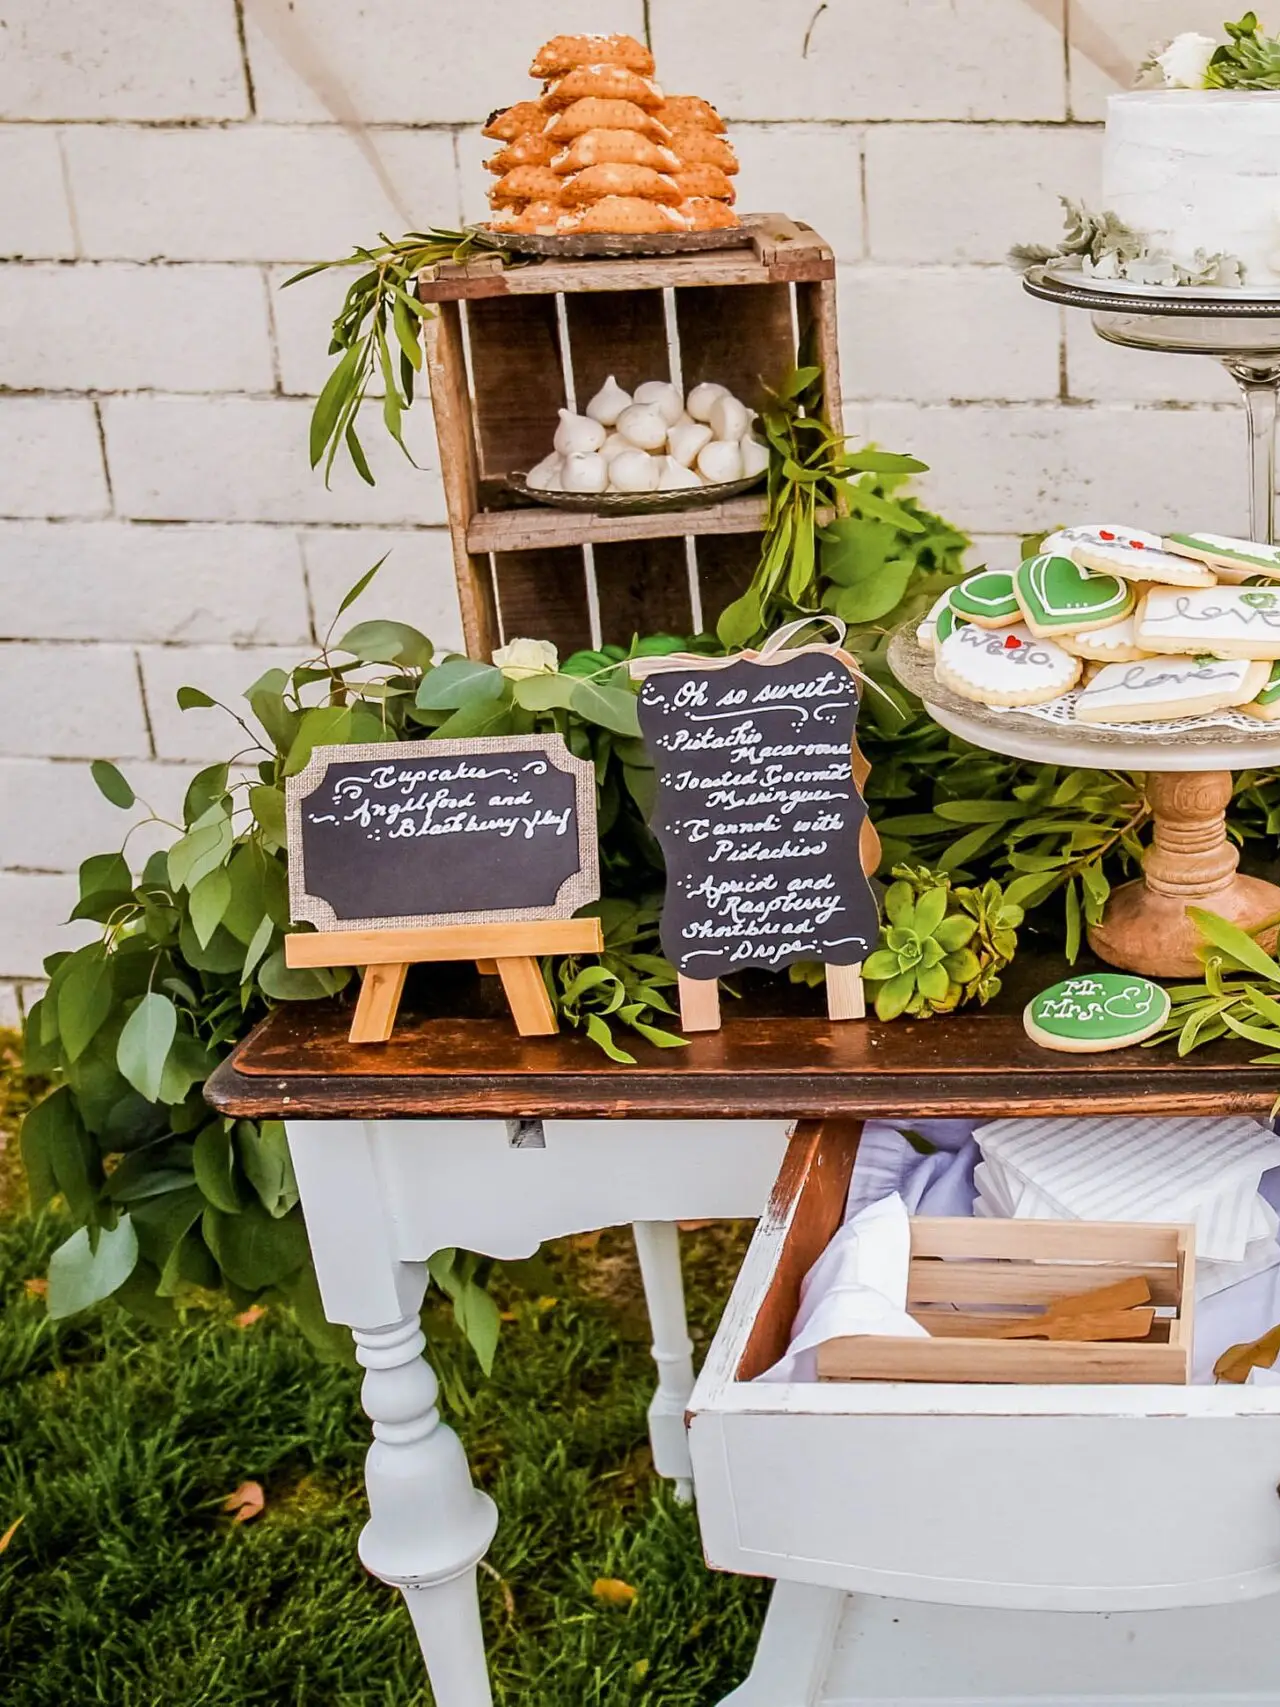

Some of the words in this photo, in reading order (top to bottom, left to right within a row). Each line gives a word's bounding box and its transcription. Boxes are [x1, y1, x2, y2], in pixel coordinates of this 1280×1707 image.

[959, 627, 1004, 655] We
[673, 680, 709, 707] Oh
[715, 688, 748, 707] so
[752, 671, 843, 704] sweet
[1079, 666, 1240, 697] love
[666, 719, 763, 751] Pistachio
[370, 761, 510, 794] Cupcakes
[674, 768, 759, 791] Toasted
[759, 763, 852, 788] Coconut
[488, 791, 534, 807] and
[388, 811, 521, 839] Blackberry
[683, 814, 782, 843] Cannoli
[792, 810, 845, 833] with
[707, 838, 828, 862] Pistachios
[686, 873, 779, 909] Apricot
[786, 873, 836, 892] and
[718, 892, 846, 925] Raspberry
[681, 918, 816, 940] Shortbread
[729, 940, 818, 965] Drops
[1060, 979, 1107, 997] Mr.
[1037, 999, 1104, 1020] Mrs.
